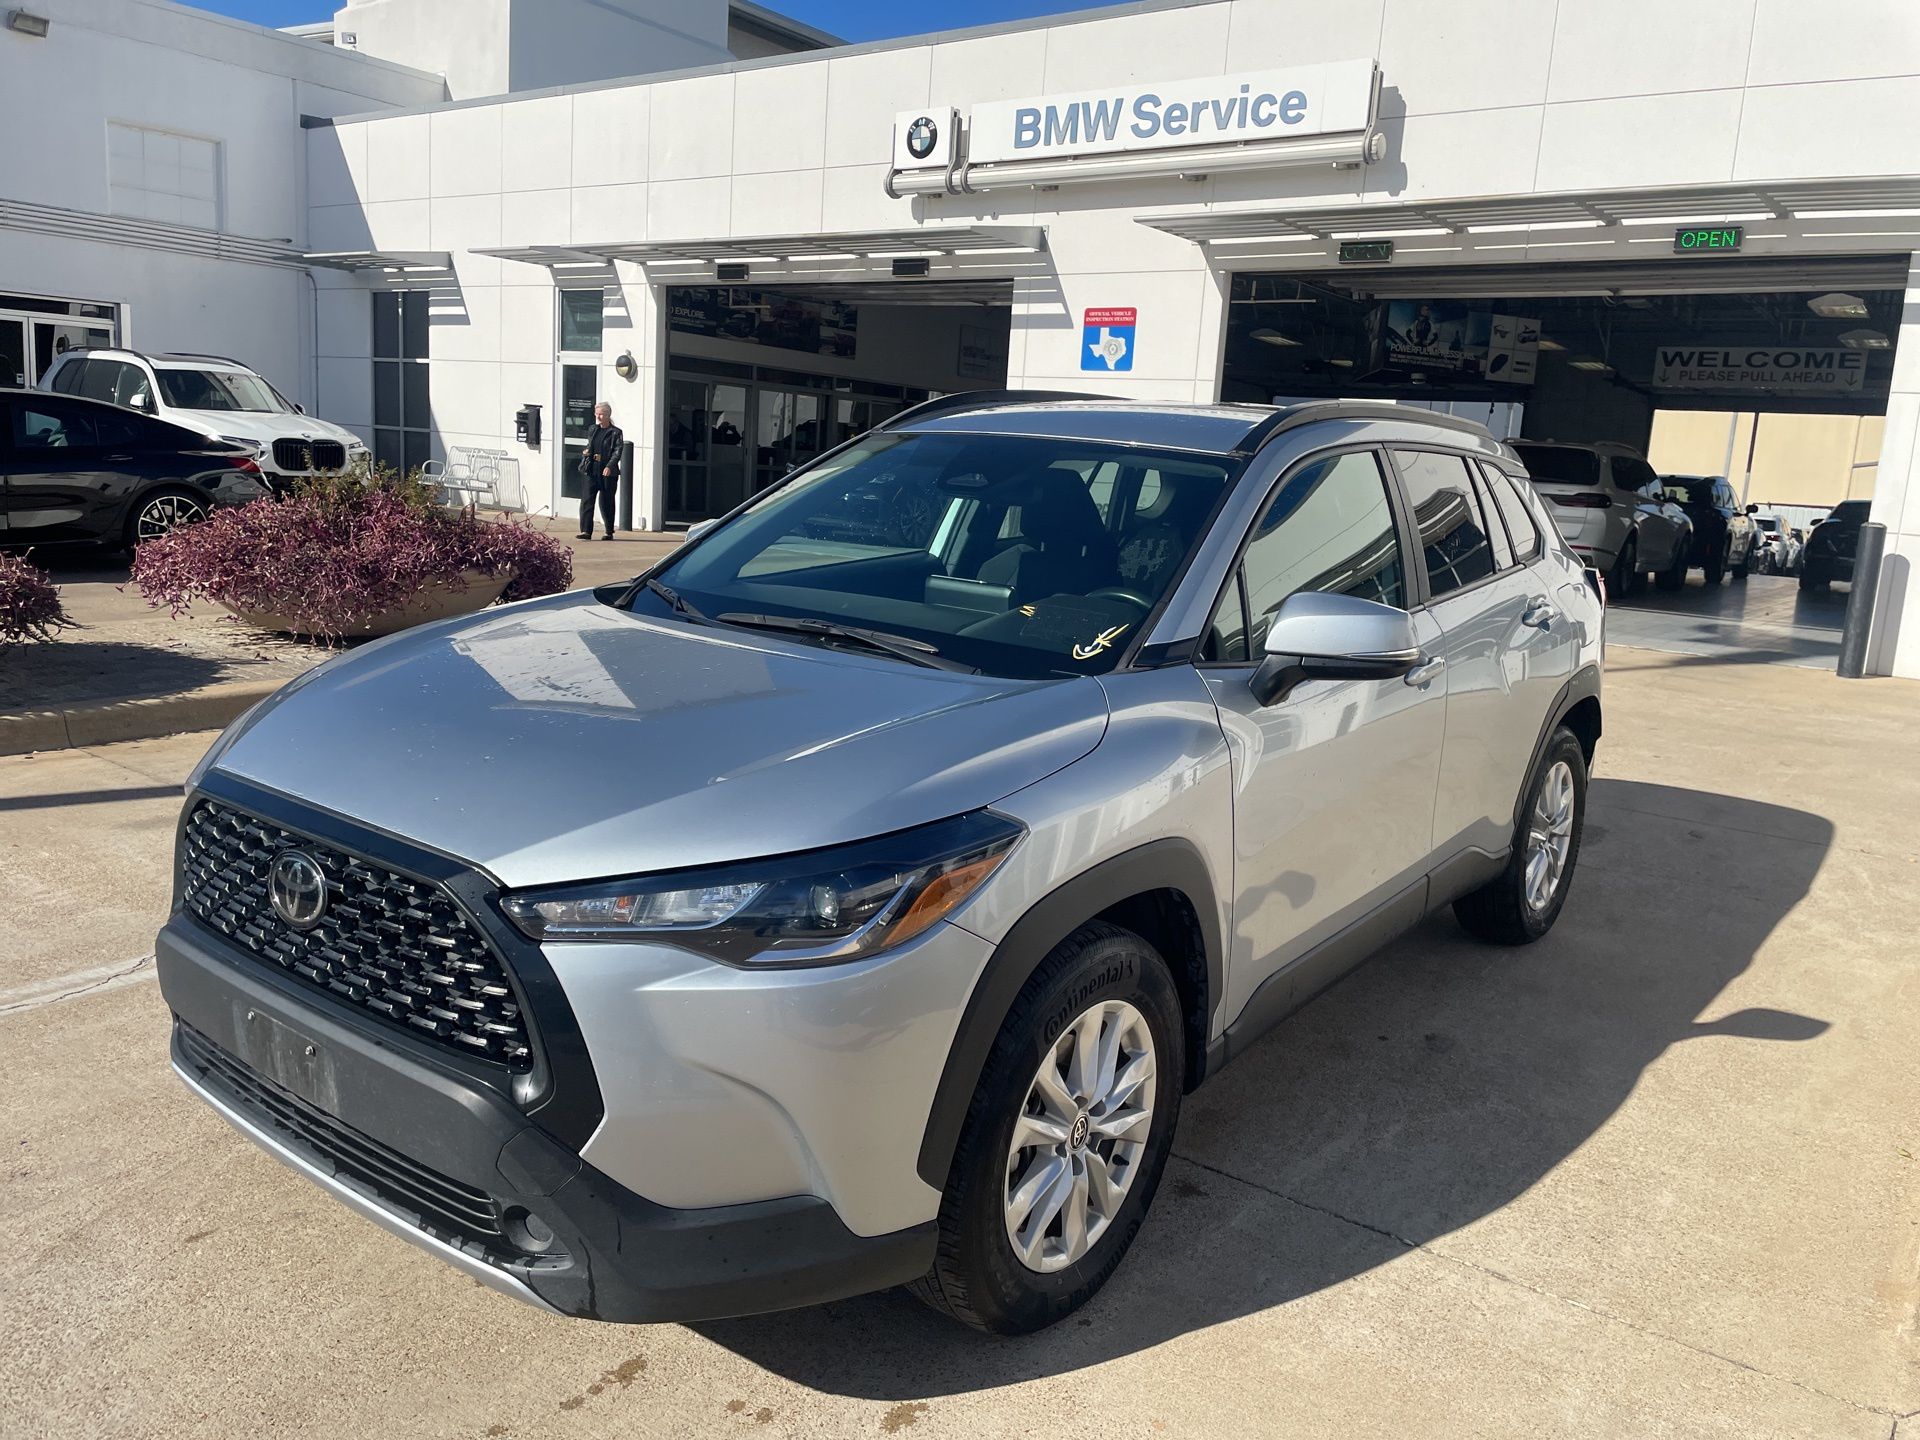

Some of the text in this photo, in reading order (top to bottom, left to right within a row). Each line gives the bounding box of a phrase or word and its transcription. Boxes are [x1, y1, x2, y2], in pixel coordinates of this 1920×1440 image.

[1014, 84, 1308, 149] BMW Service
[1681, 230, 1736, 248] OPEN
[1390, 343, 1428, 355] POWERFUL
[1661, 351, 1863, 369] WELCOME
[1679, 370, 1836, 383] PLEASE PULL AHEAD
[1043, 960, 1124, 1045] Continental
